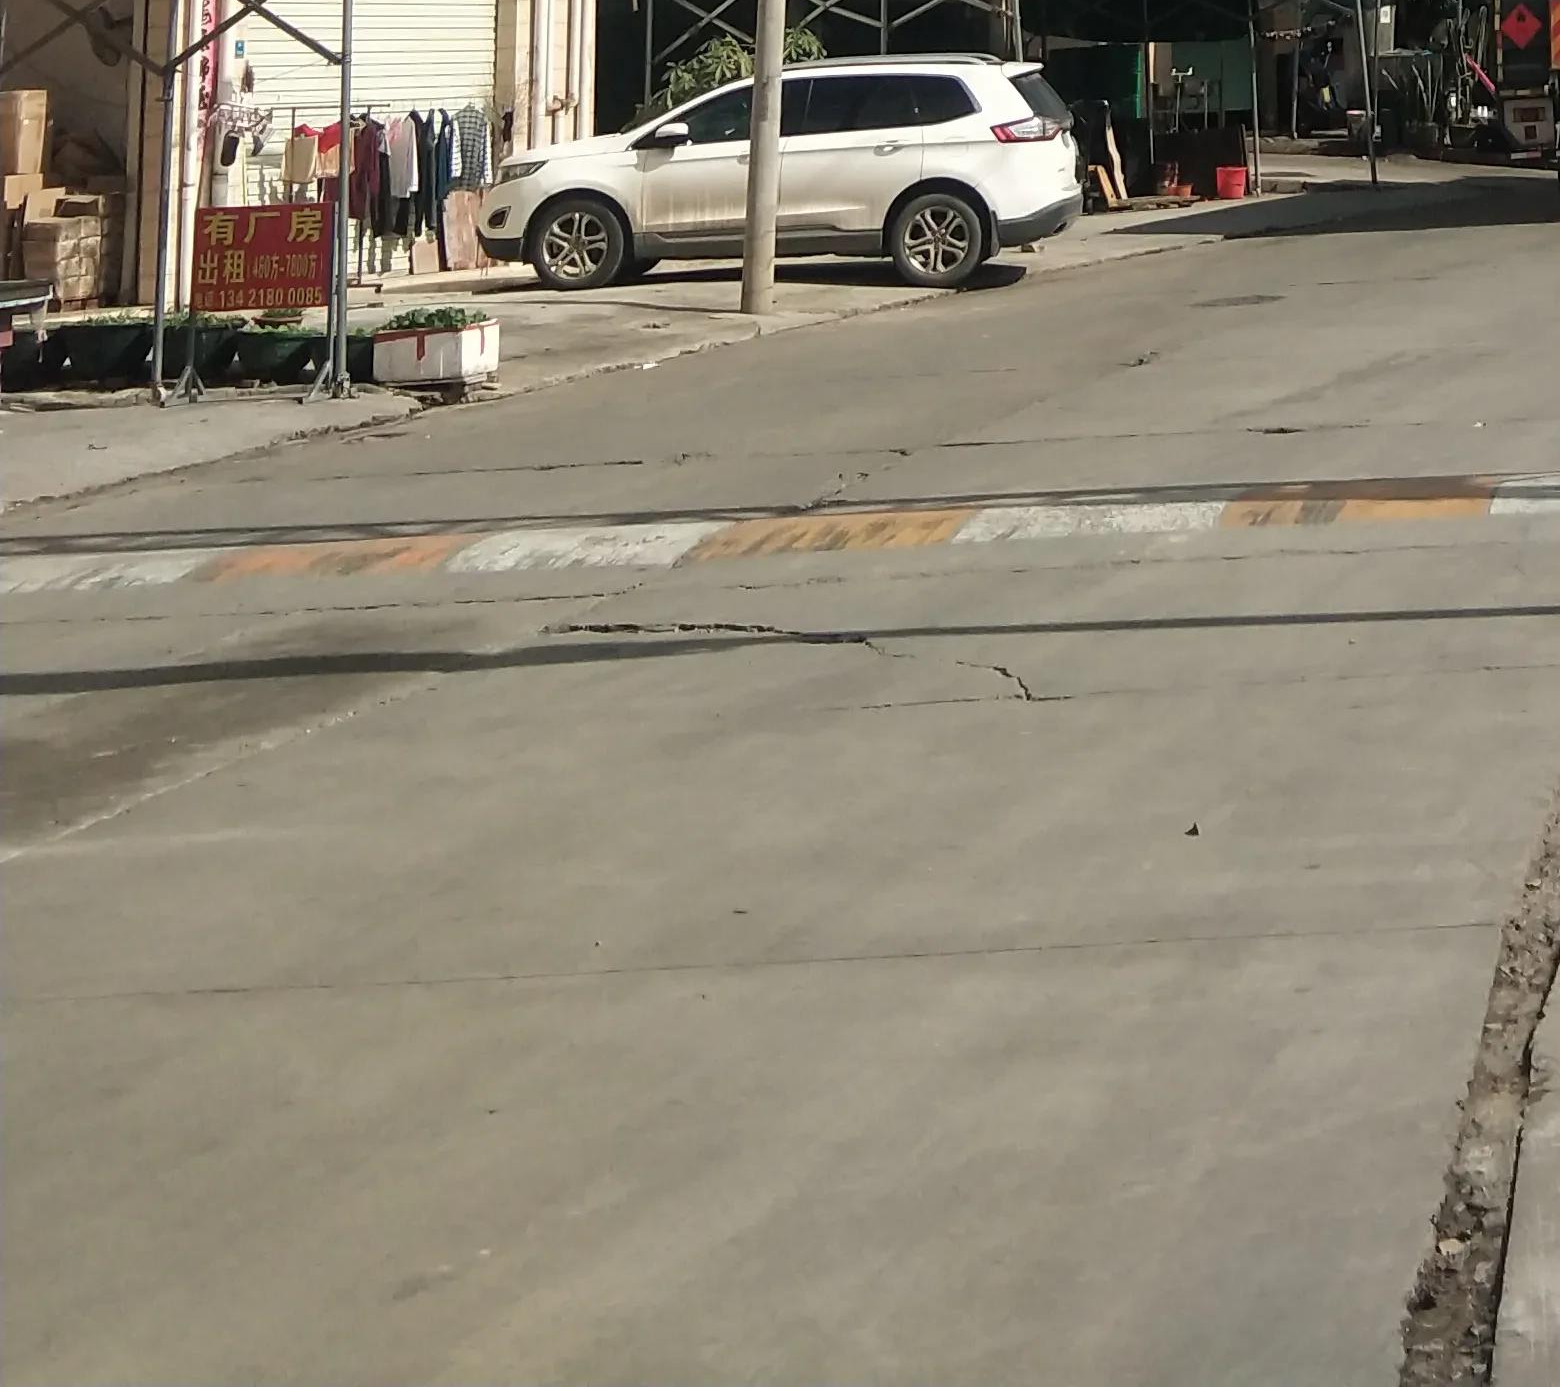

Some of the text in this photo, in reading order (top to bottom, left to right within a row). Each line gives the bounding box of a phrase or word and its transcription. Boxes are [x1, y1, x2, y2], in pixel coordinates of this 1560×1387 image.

[203, 207, 324, 246] 有厂房
[198, 249, 245, 286] 出租
[219, 289, 244, 308] 134
[248, 287, 284, 307] 2180
[287, 285, 323, 305] 0085
